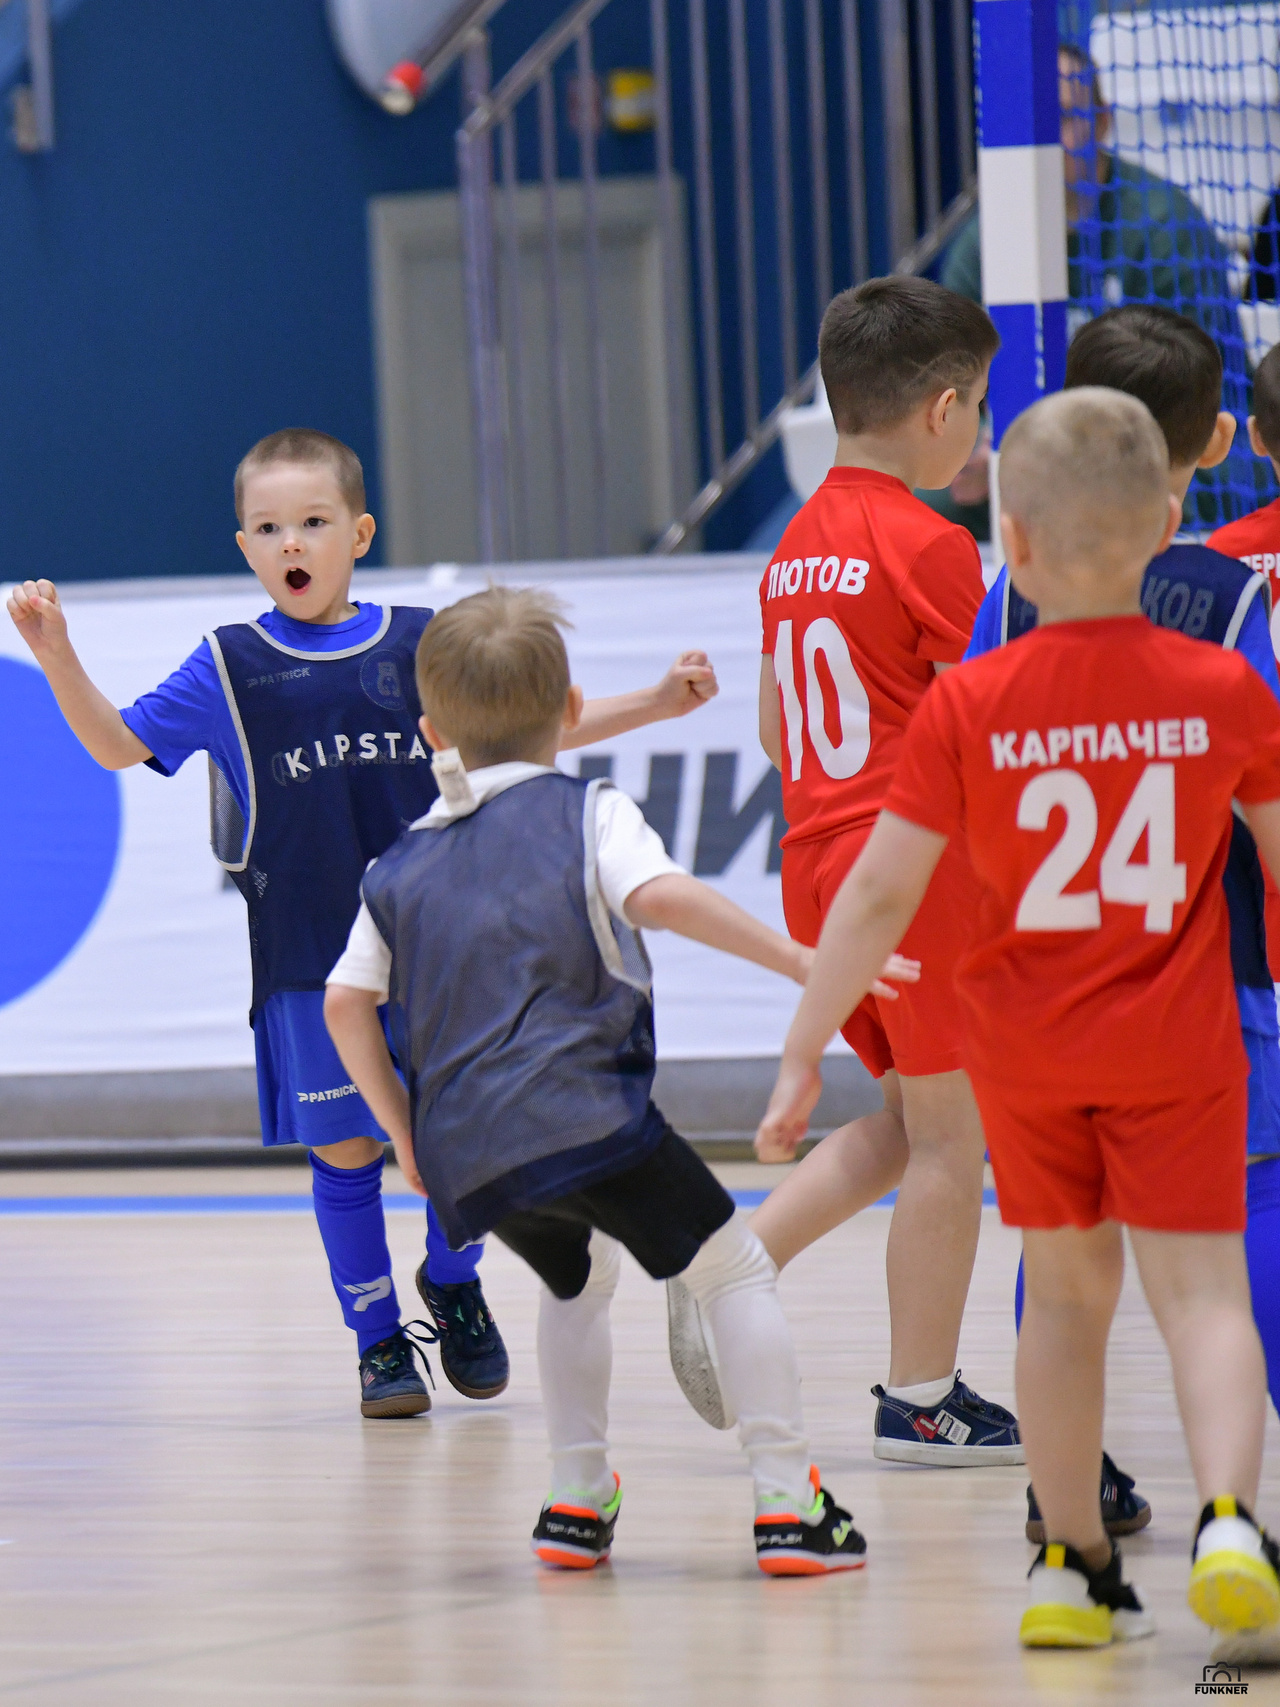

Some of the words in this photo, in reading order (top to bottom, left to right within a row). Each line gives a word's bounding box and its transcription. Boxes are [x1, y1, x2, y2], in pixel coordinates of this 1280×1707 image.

[766, 555, 870, 602] ЛЮТОВ
[772, 617, 871, 782] 10
[284, 732, 428, 778] KIPSTA
[989, 716, 1210, 770] КАРПАЧЕВ
[1014, 762, 1187, 935] 24
[309, 1083, 358, 1103] PATRICK
